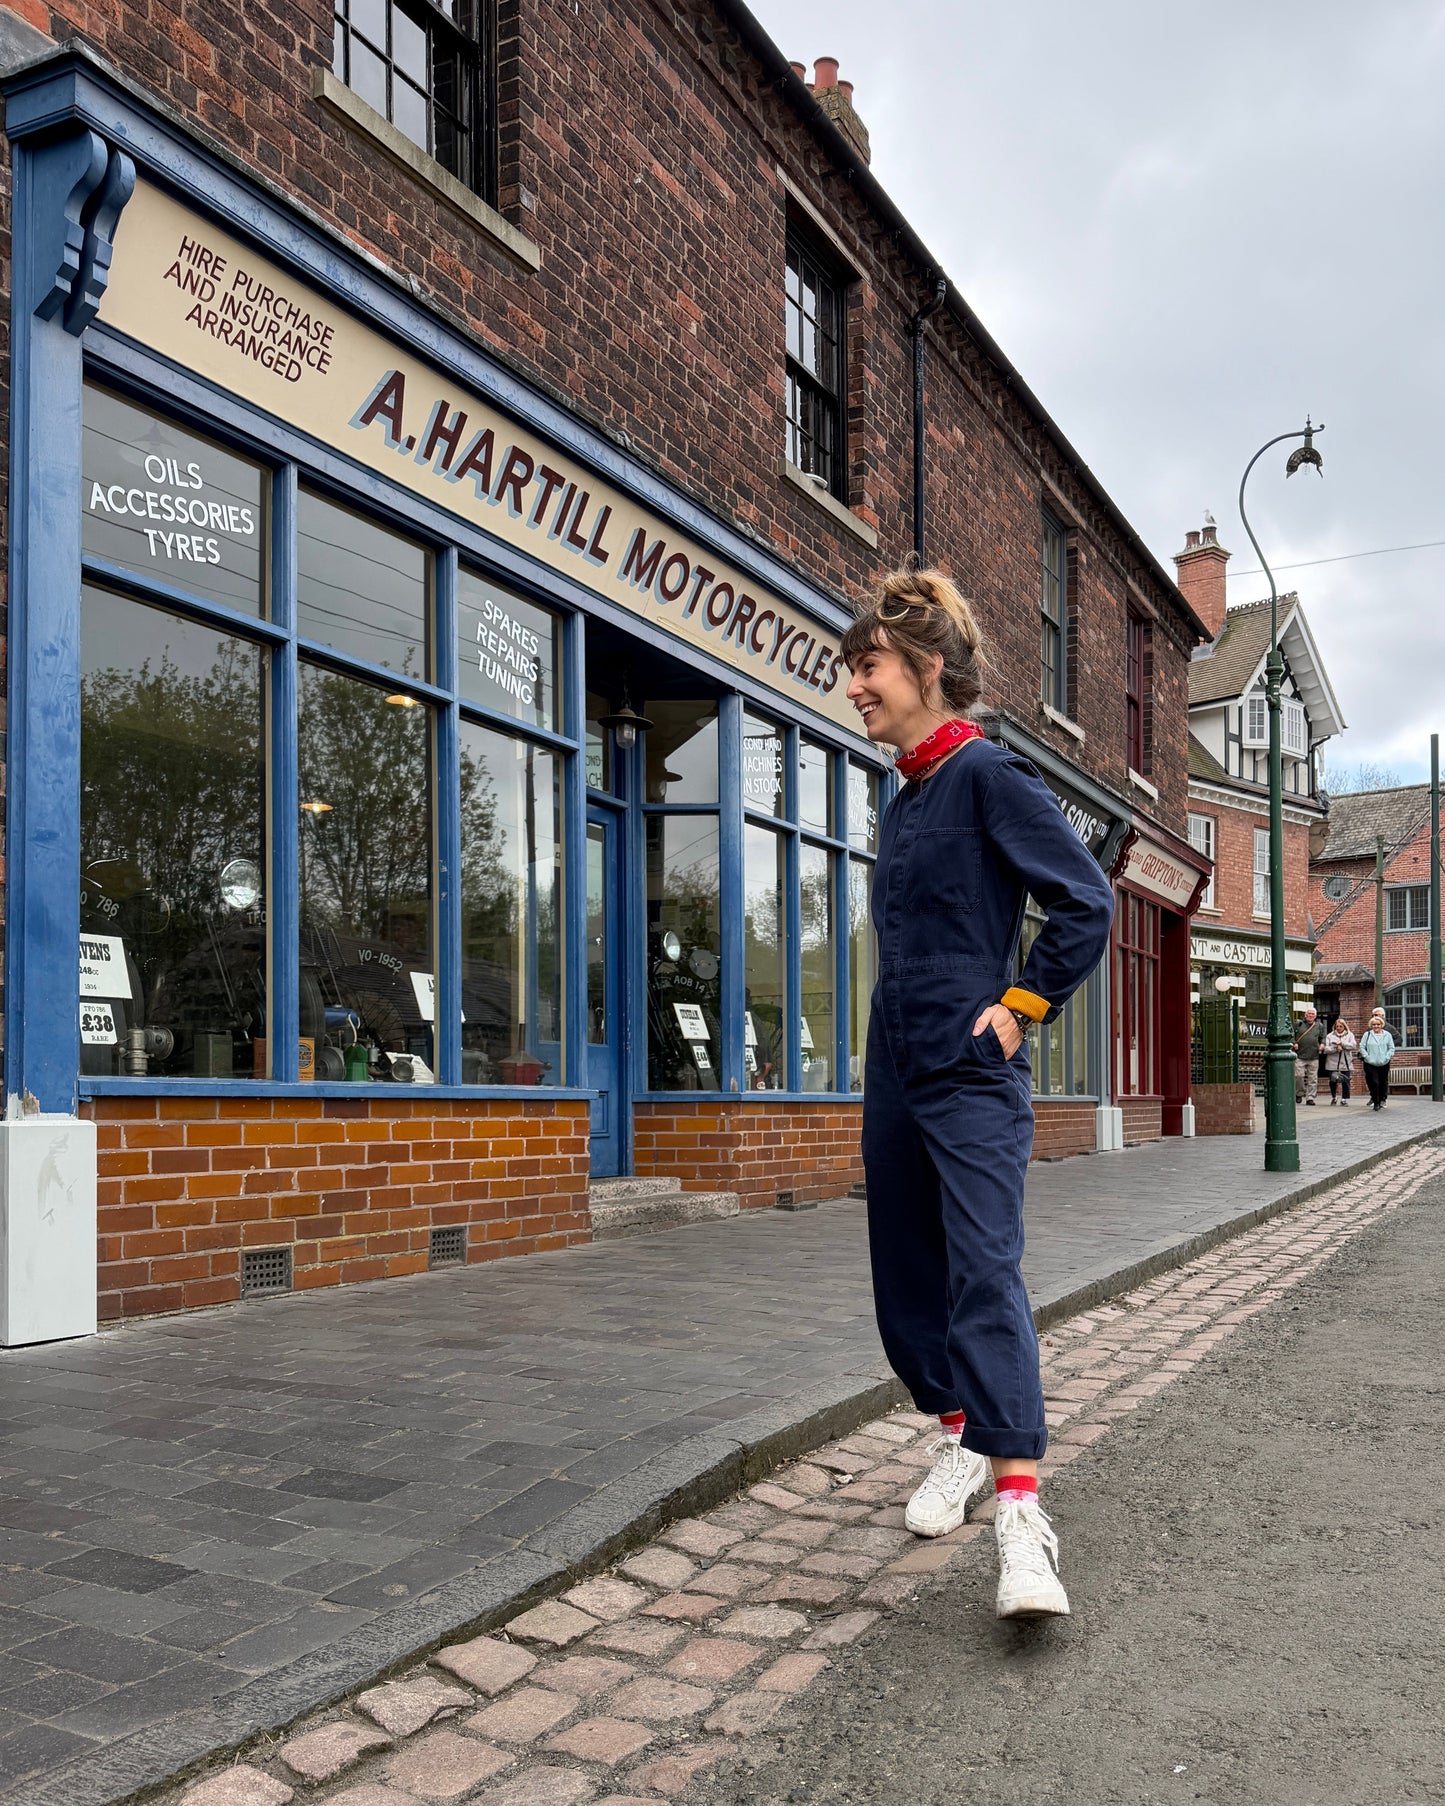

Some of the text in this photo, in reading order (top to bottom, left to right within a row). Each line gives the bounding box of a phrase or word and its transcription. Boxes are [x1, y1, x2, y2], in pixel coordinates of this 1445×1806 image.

[178, 235, 335, 349] HIRE PURCHASE
[163, 261, 333, 375] AND INSURANCE
[185, 303, 302, 383] ARRANGED
[144, 454, 203, 490] OILS
[89, 482, 255, 535] ACCESSORIES
[143, 528, 221, 564] TYRES
[482, 600, 539, 655] SPARES
[620, 527, 844, 697] MOTORCYCLES
[476, 622, 539, 682] REPAIRS
[477, 650, 533, 705] TUNING
[754, 777, 782, 793] STOCK
[1066, 804, 1098, 844] SONS
[96, 894, 120, 917] 786
[79, 941, 111, 961] VENS
[1210, 944, 1221, 953] AND
[1223, 943, 1271, 964] CASTLE
[673, 975, 693, 987] AOB
[82, 1013, 114, 1032] £38
